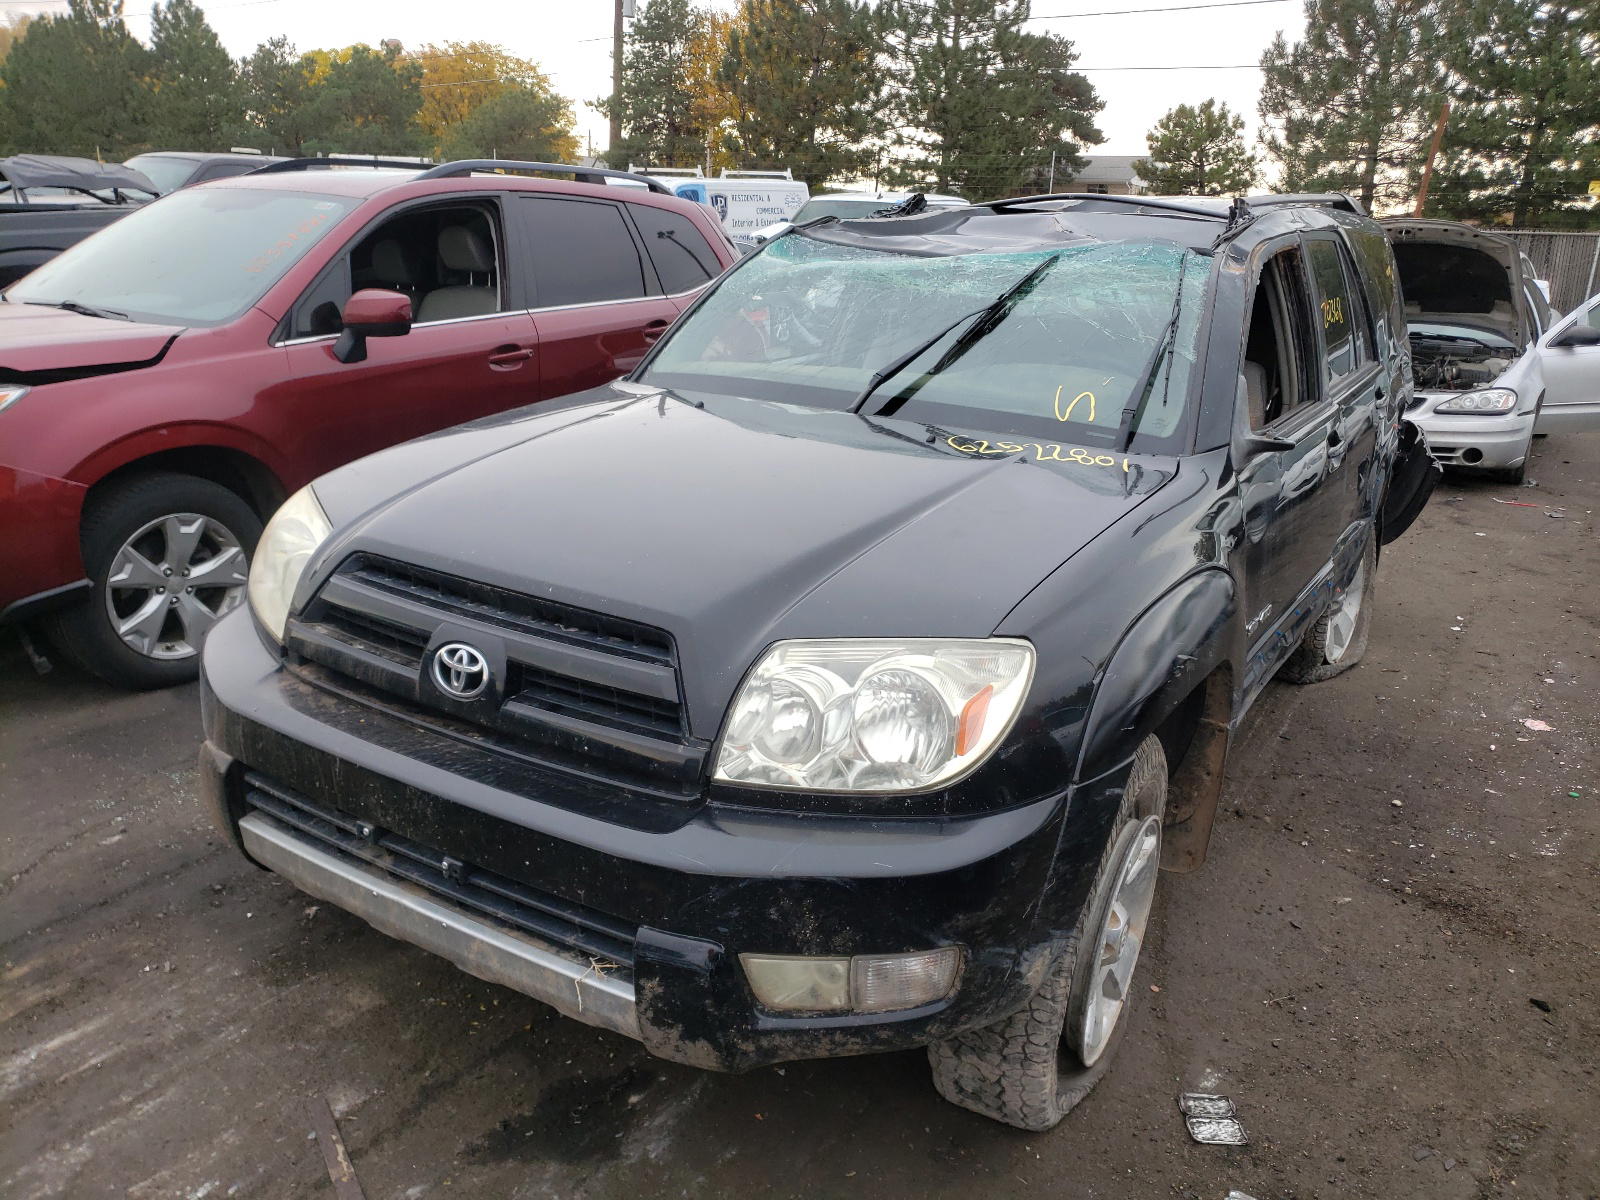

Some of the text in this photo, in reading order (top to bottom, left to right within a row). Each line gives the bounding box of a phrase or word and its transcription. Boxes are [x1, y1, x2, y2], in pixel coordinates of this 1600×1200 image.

[731, 194, 764, 202] RESIDENTIAL
[756, 207, 785, 216] COMMERCIAL
[732, 218, 753, 228] Interior
